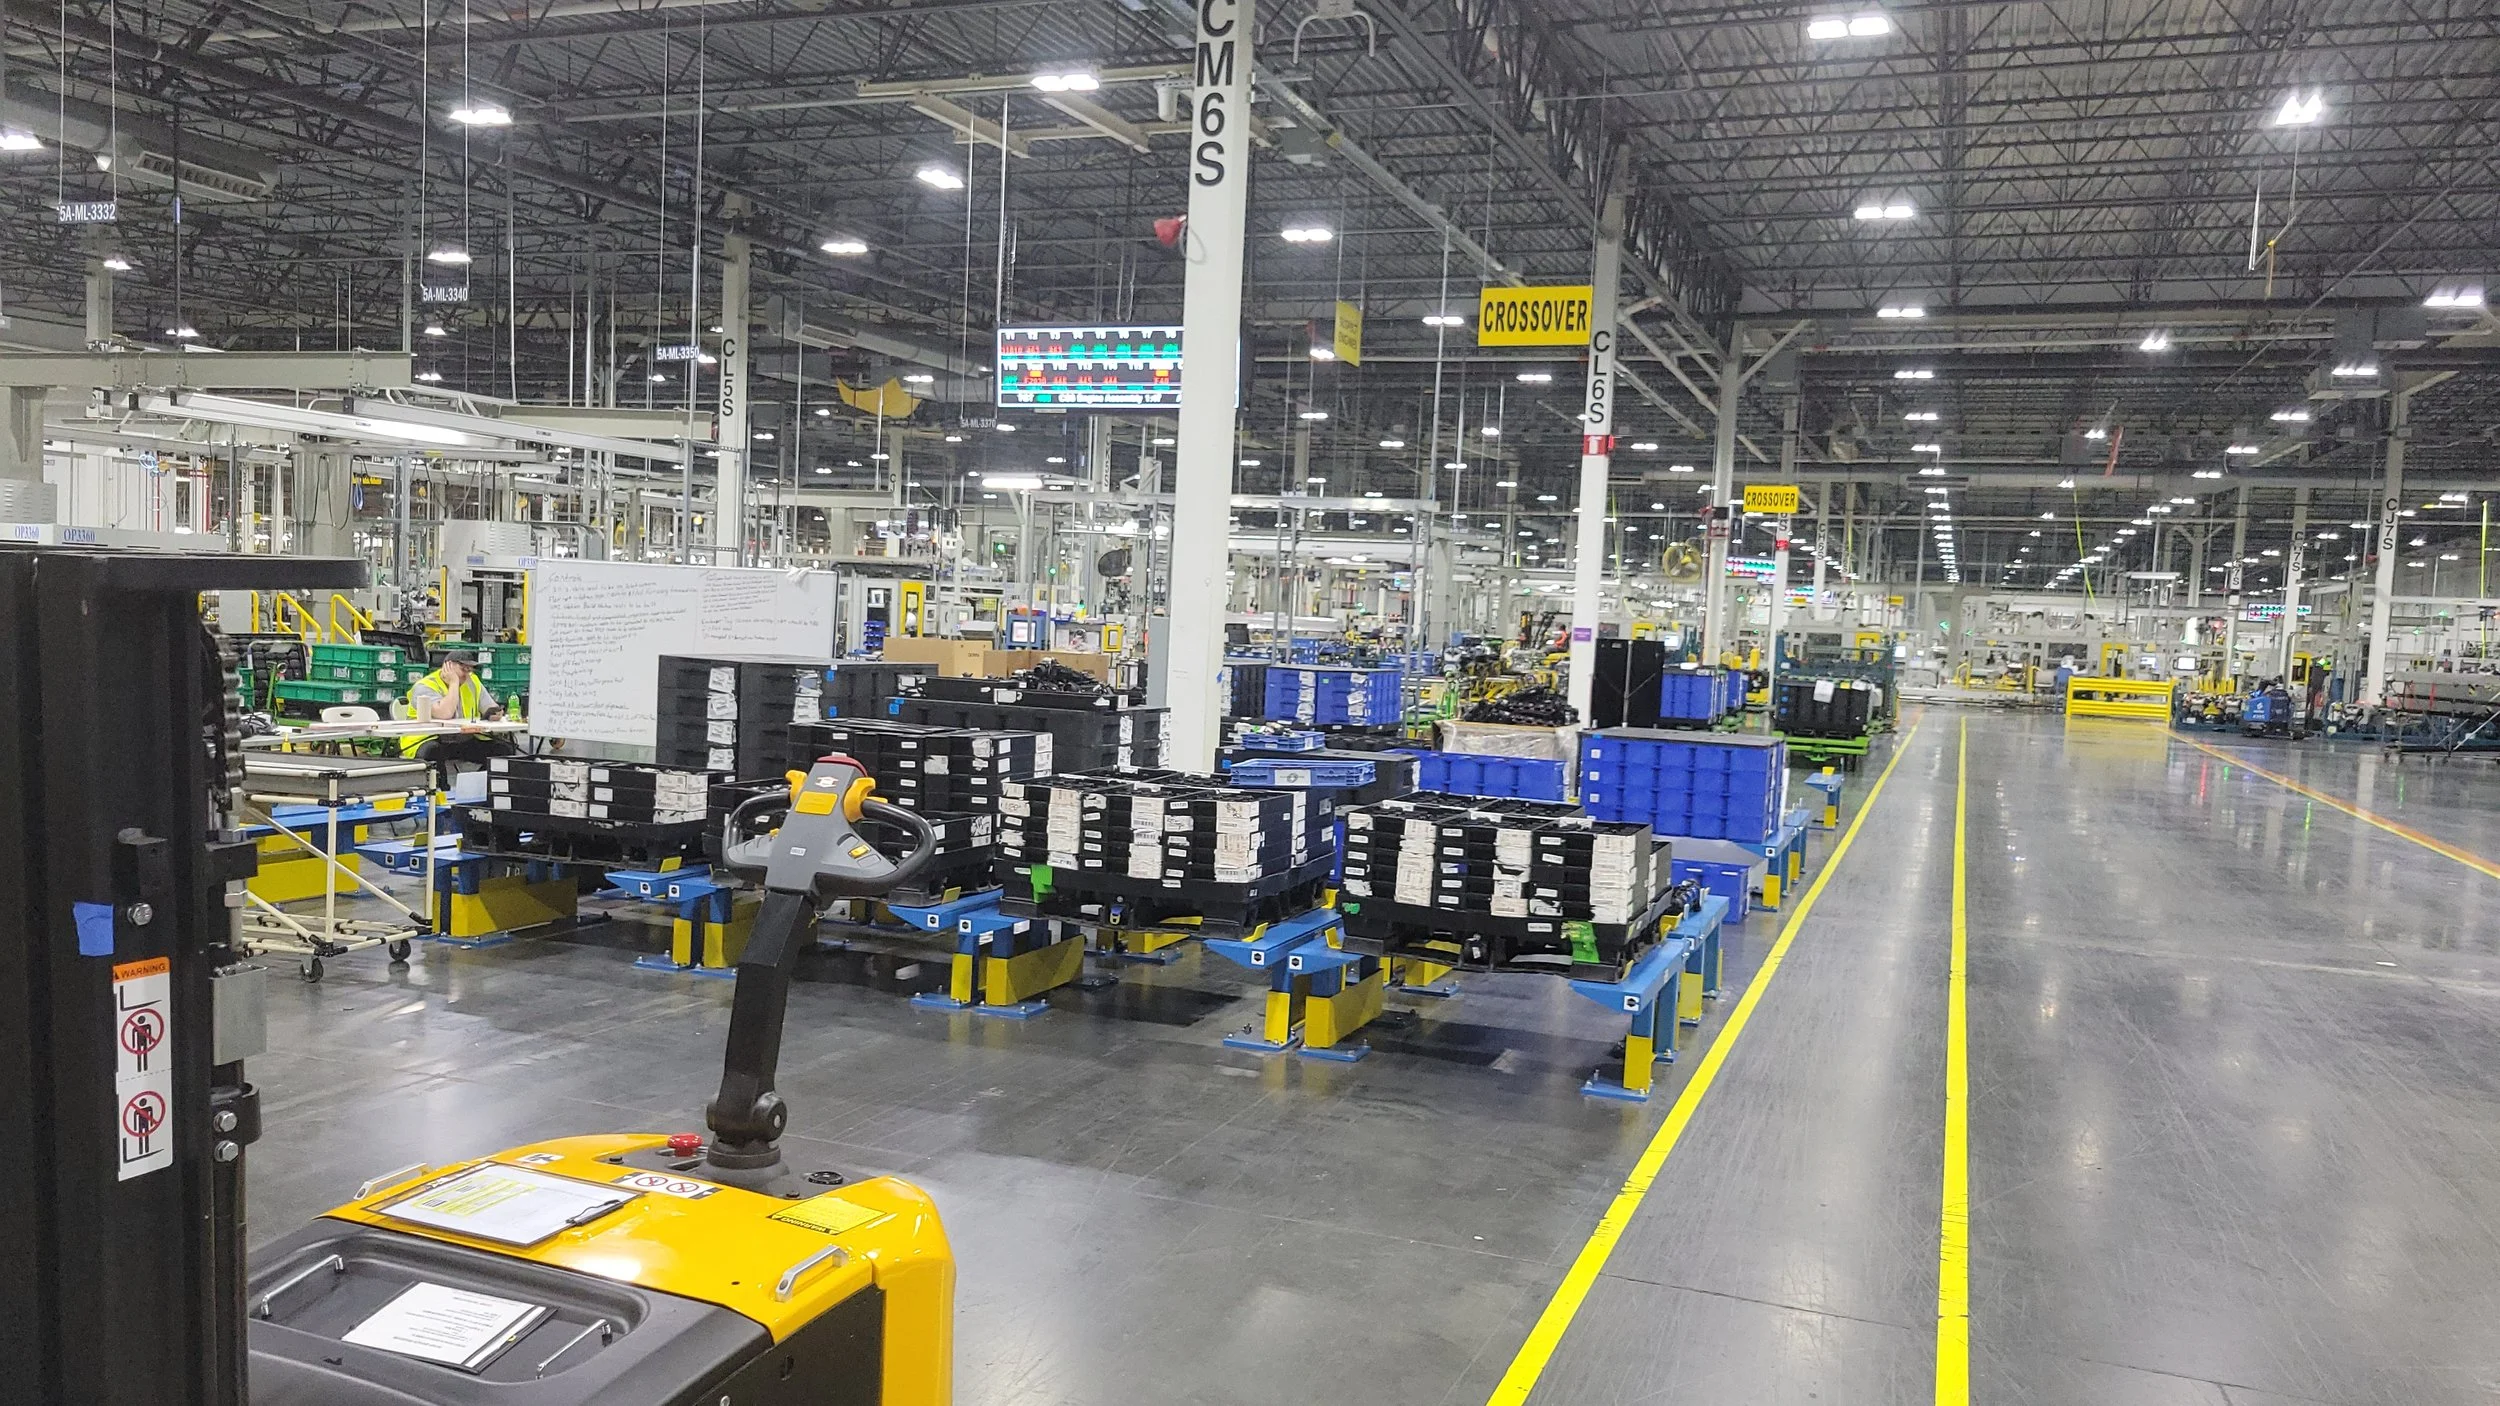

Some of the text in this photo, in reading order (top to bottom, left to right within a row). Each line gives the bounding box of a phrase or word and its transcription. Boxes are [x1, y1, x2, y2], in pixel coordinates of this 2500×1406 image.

[1195, 0, 1236, 187] CM6S
[60, 203, 116, 222] 5A-ML-3332
[423, 287, 468, 302] 5A-ML-3340
[1483, 300, 1588, 332] CROSSOVER
[657, 346, 700, 360] 5A-ML-3350
[722, 338, 736, 417] CL5S
[1588, 331, 1611, 423] CL6S
[1745, 492, 1796, 507] CROSSOVER
[2383, 498, 2398, 550] CJ7S
[63, 528, 96, 543] OP3360
[121, 963, 166, 978] WARNING
[780, 1216, 826, 1233] WARNING
